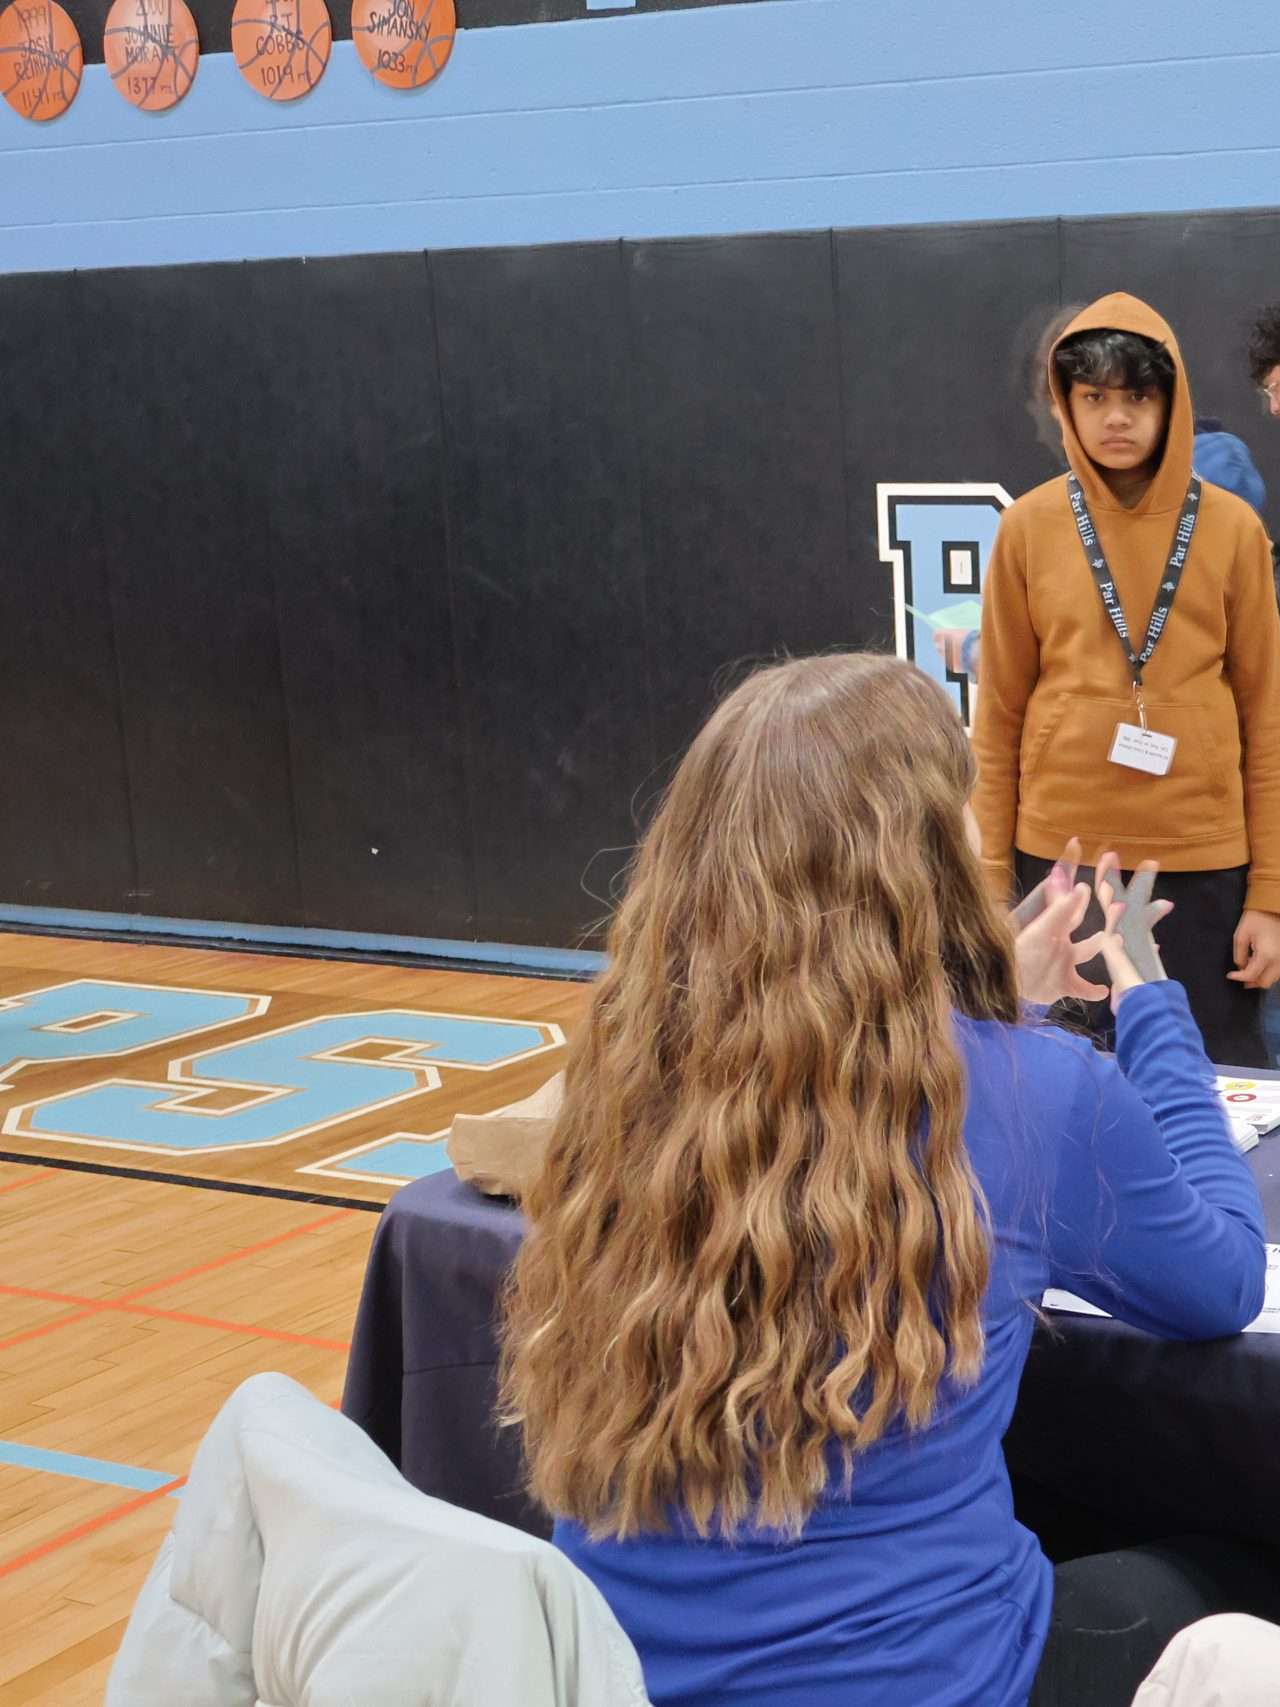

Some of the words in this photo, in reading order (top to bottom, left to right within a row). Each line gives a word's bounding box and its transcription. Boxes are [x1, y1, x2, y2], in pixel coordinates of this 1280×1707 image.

[1070, 491, 1083, 513] Par
[1076, 513, 1095, 546] Hills
[1176, 513, 1195, 543] Hills
[1169, 543, 1188, 568] Par
[1100, 582, 1116, 605] Par
[1108, 606, 1129, 638] Hills
[1139, 638, 1155, 663] Par
[1147, 607, 1168, 638] Hills
